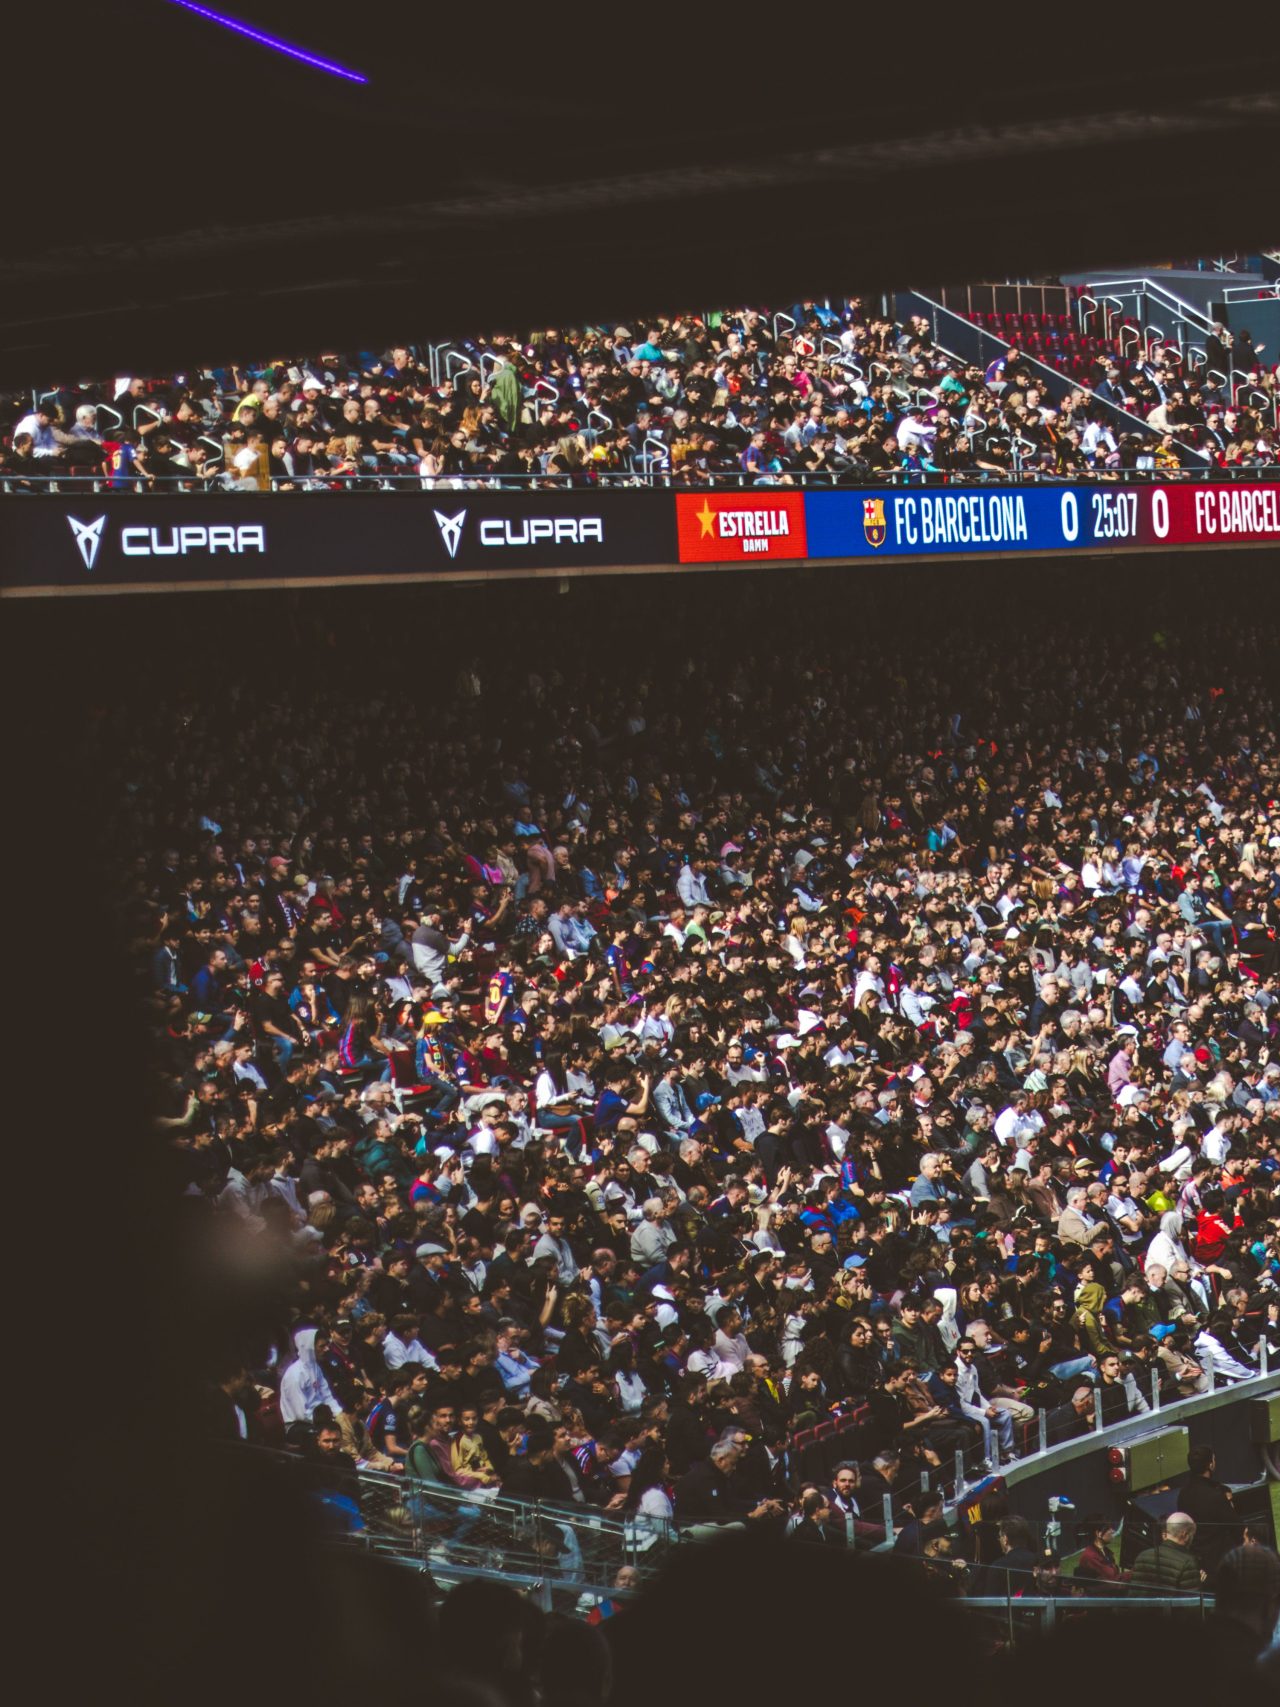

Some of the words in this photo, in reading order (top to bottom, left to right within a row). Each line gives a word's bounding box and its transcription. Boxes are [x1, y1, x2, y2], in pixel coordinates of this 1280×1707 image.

[480, 518, 603, 545] CUPRA
[718, 510, 790, 538] ESTRELLA
[895, 498, 918, 545] FC
[920, 495, 1028, 543] BARCELONA
[1060, 491, 1079, 542] 0
[1092, 493, 1138, 537] 25:07
[1151, 489, 1170, 538] 0
[1195, 491, 1217, 534] FC
[121, 525, 265, 555] CUPRA
[742, 538, 769, 553] DAMM
